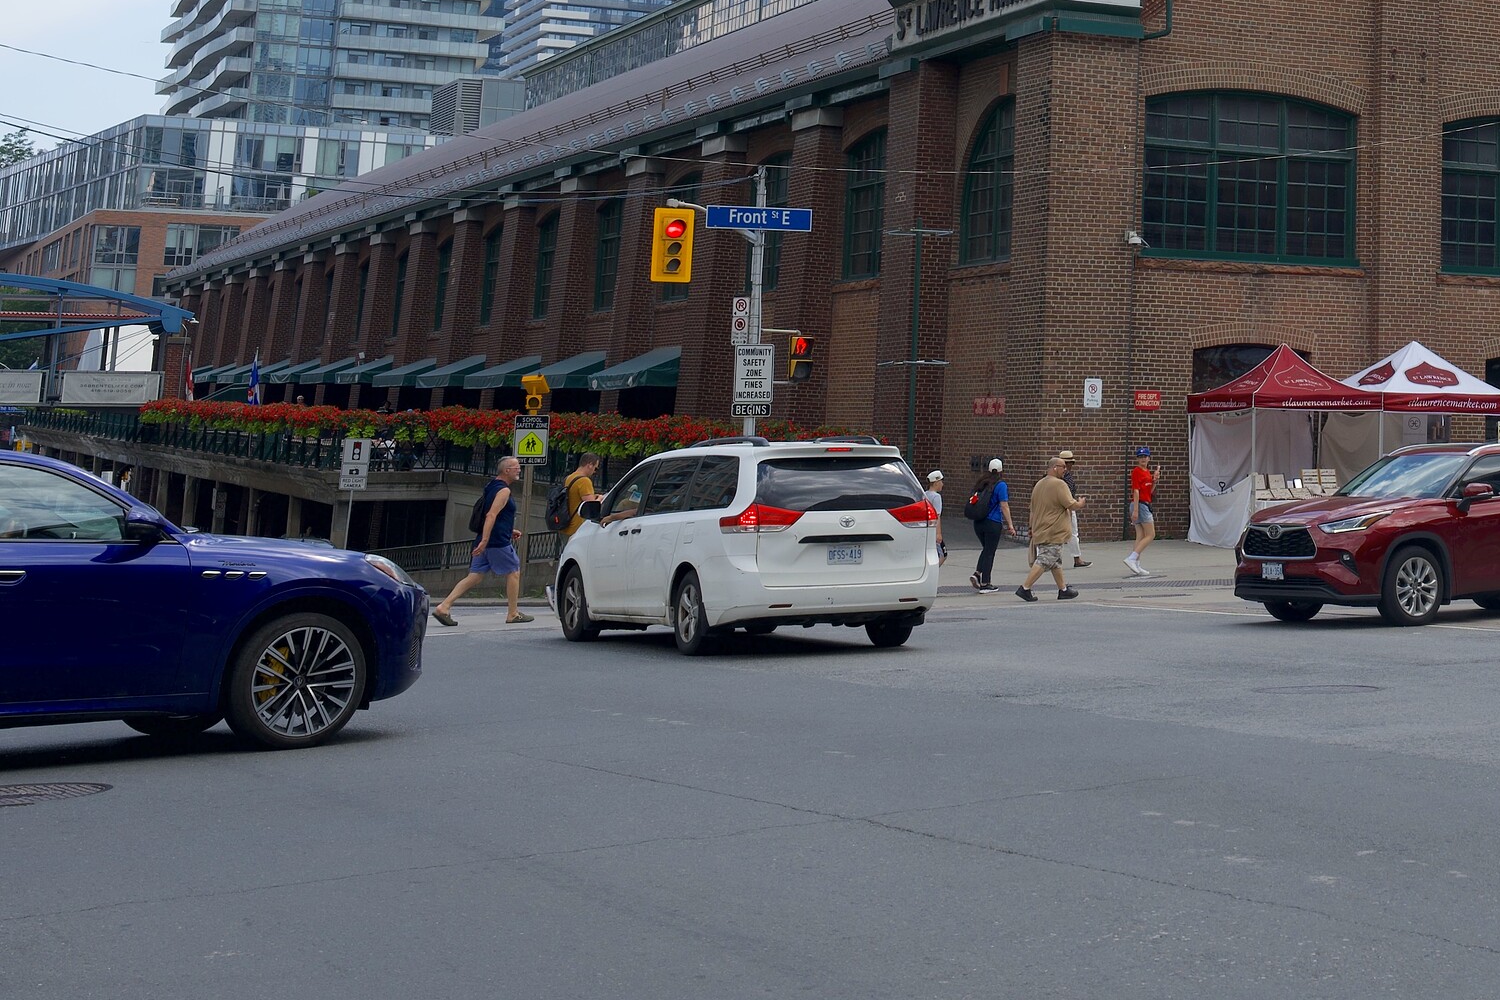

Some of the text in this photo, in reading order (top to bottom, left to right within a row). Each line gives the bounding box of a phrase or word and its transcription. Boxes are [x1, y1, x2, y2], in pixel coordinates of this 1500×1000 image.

[729, 208, 790, 225] Front St E
[738, 348, 772, 356] COMMUNITY
[746, 369, 762, 377] ZONE
[744, 381, 763, 389] FINES
[736, 391, 771, 399] INCREASED
[1281, 397, 1371, 407] stlawrencemarket.com
[1407, 398, 1497, 410] stlawrencemarket.com
[735, 405, 767, 415] BEGINS
